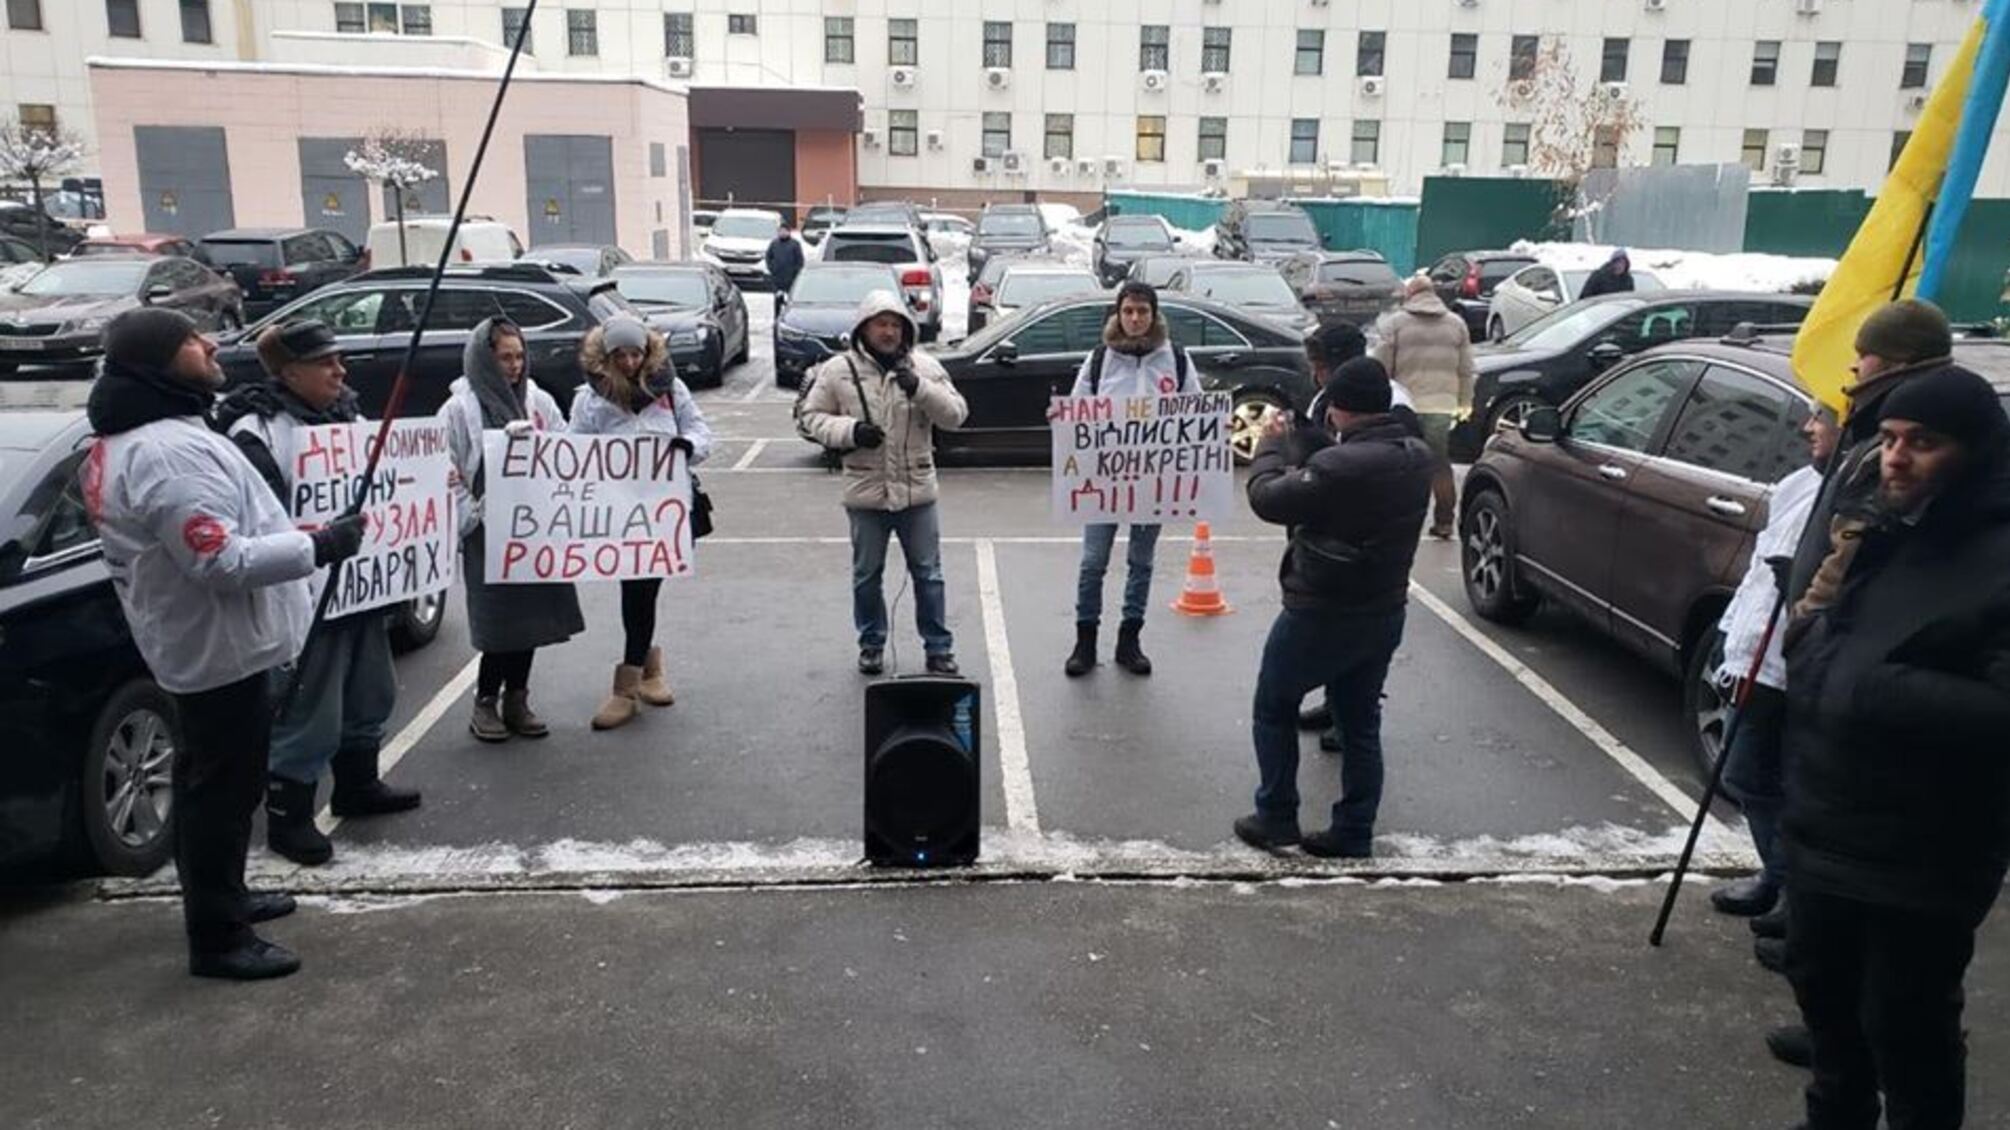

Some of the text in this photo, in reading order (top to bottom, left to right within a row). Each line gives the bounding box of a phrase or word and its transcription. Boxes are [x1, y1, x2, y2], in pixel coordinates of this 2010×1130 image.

[1059, 398, 1113, 421] НАМ
[1125, 397, 1152, 418] НЕ
[502, 435, 677, 481] ЕКОЛОГИ
[1063, 455, 1079, 476] А
[551, 482, 596, 501] ДЕ
[511, 503, 653, 539] ВАША
